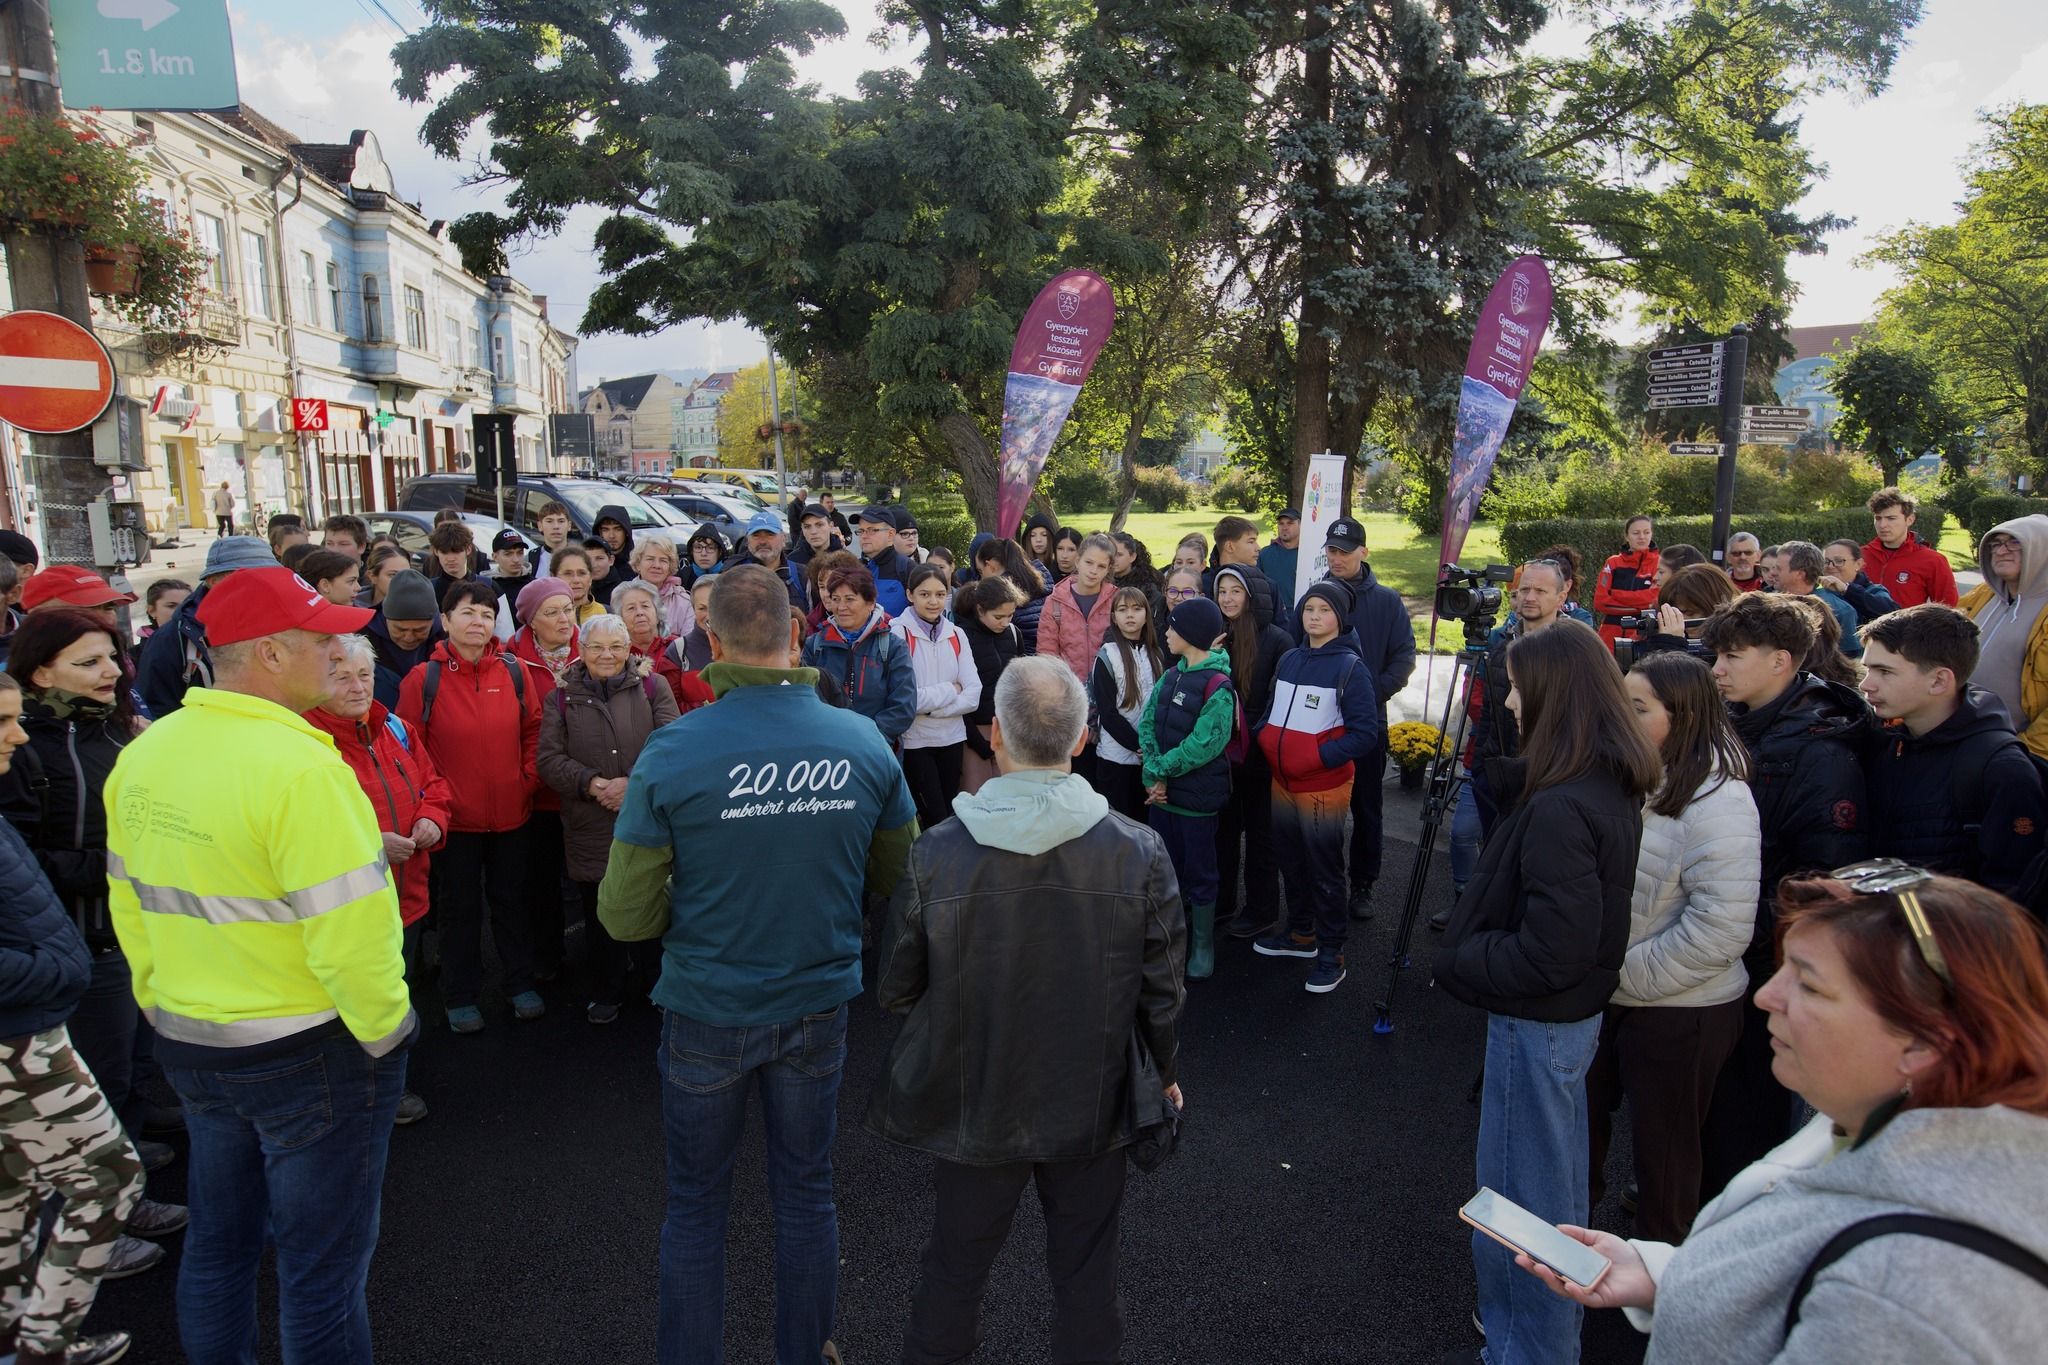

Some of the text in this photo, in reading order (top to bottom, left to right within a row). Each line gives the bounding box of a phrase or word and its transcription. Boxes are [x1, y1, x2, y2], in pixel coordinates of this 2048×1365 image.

[97, 47, 195, 75] 1.8 km
[1045, 319, 1088, 336] Gyergyóért
[1046, 343, 1082, 357] közösen!
[1051, 333, 1081, 346] tesszük
[1487, 365, 1521, 388] GyerTeK!
[728, 759, 851, 799] 20.000
[720, 796, 857, 820] emberért dolgozom
